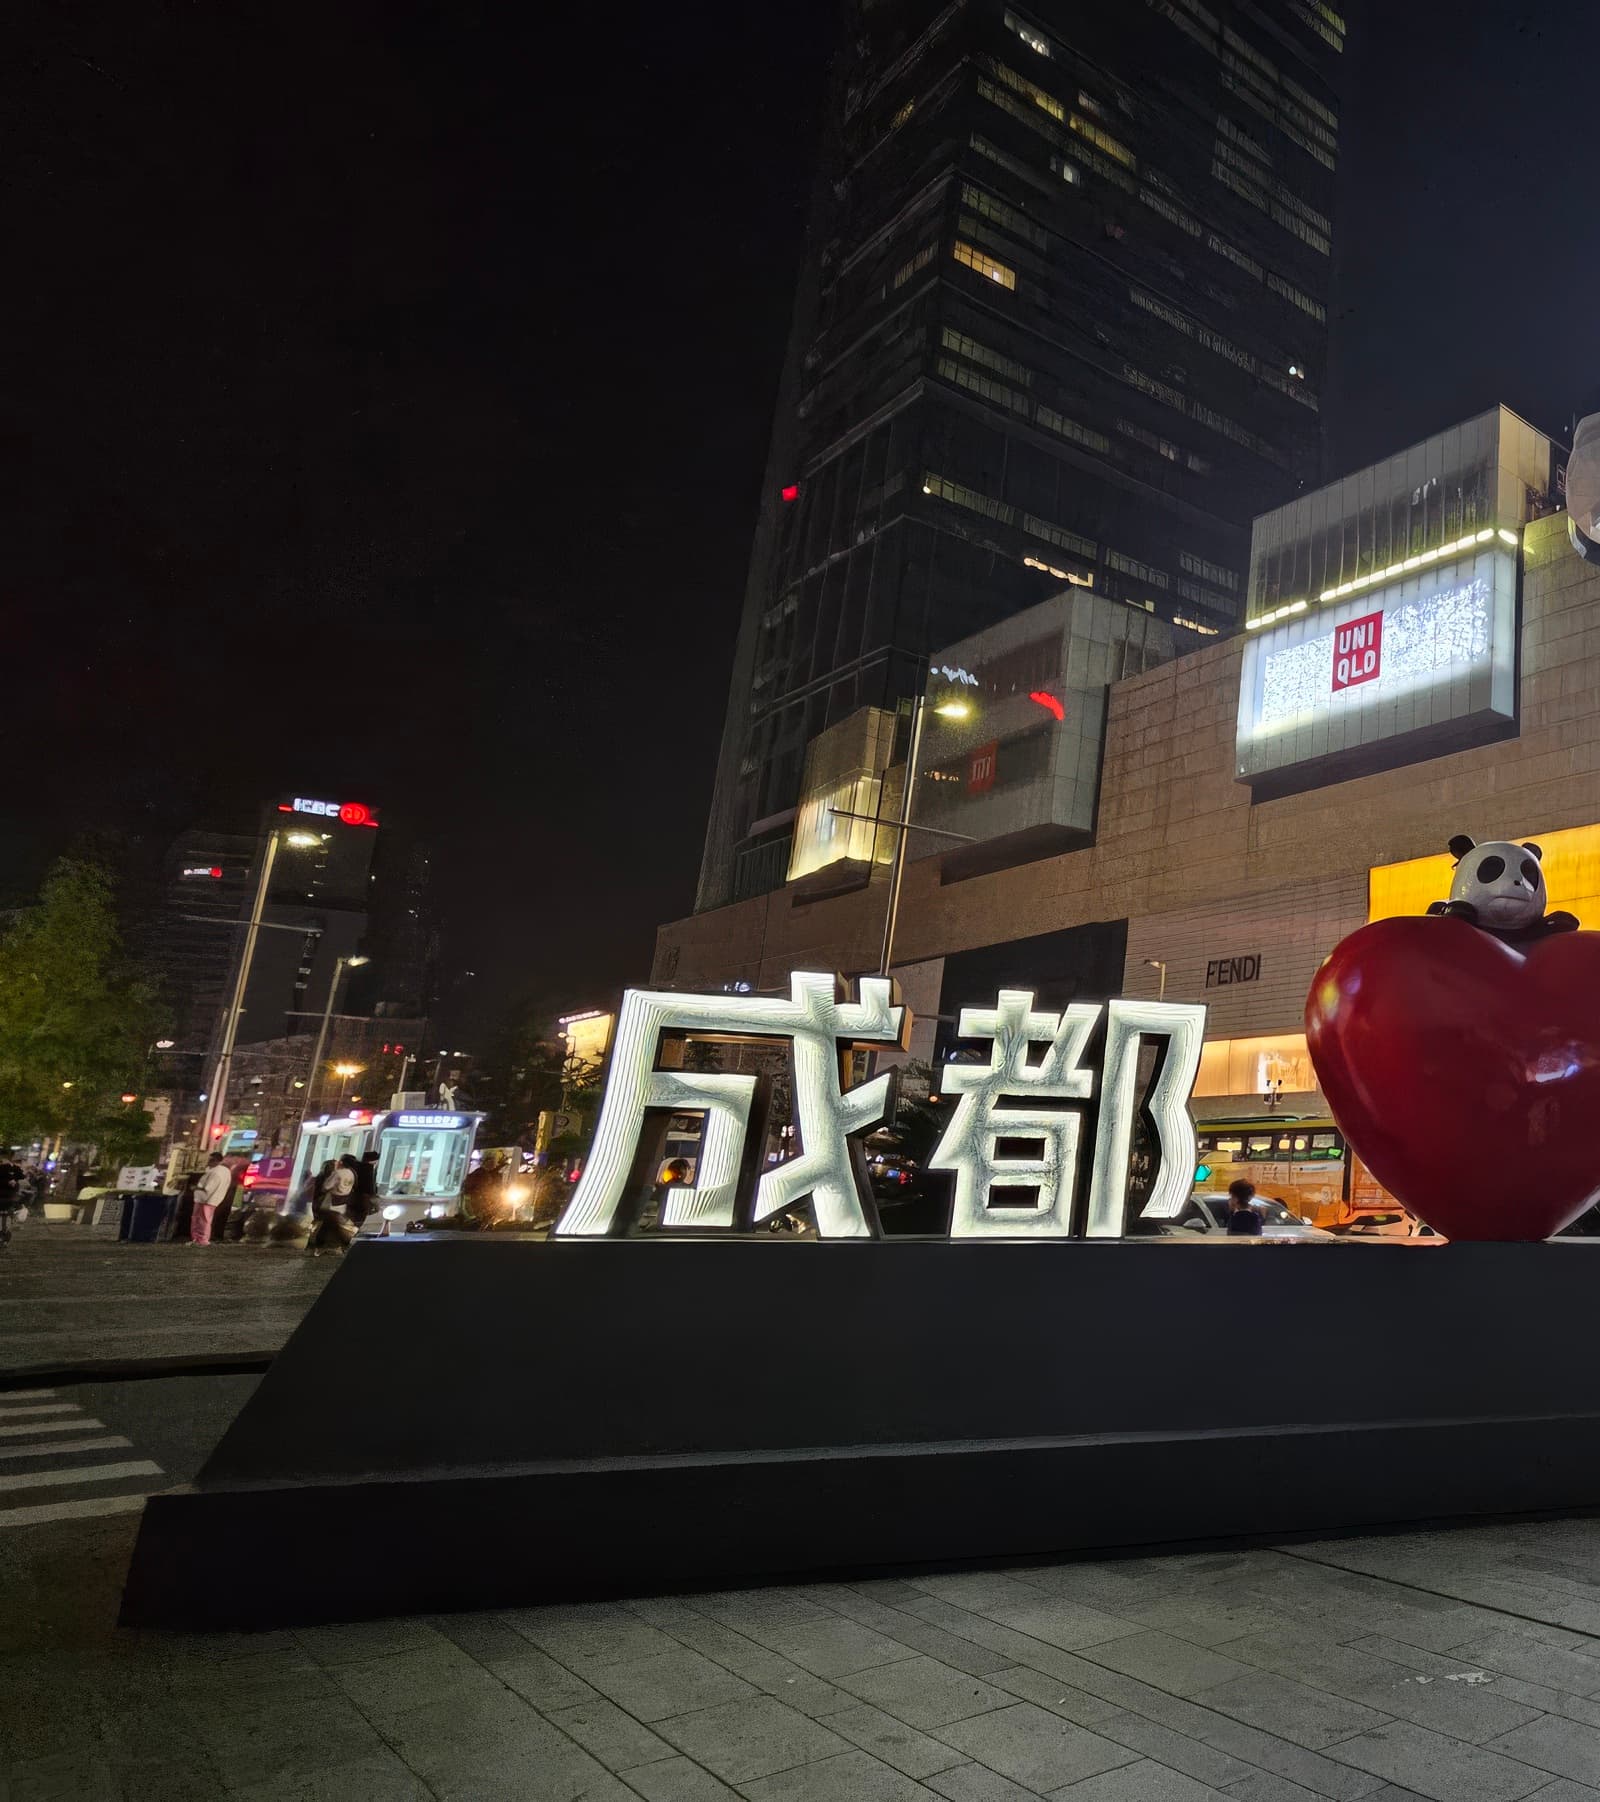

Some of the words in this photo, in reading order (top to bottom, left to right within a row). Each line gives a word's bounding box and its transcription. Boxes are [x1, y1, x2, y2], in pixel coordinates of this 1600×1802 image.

[1339, 621, 1374, 654] UNI
[1337, 649, 1376, 685] QLO
[1205, 953, 1262, 988] FENDI
[555, 971, 1207, 1239] 成都
